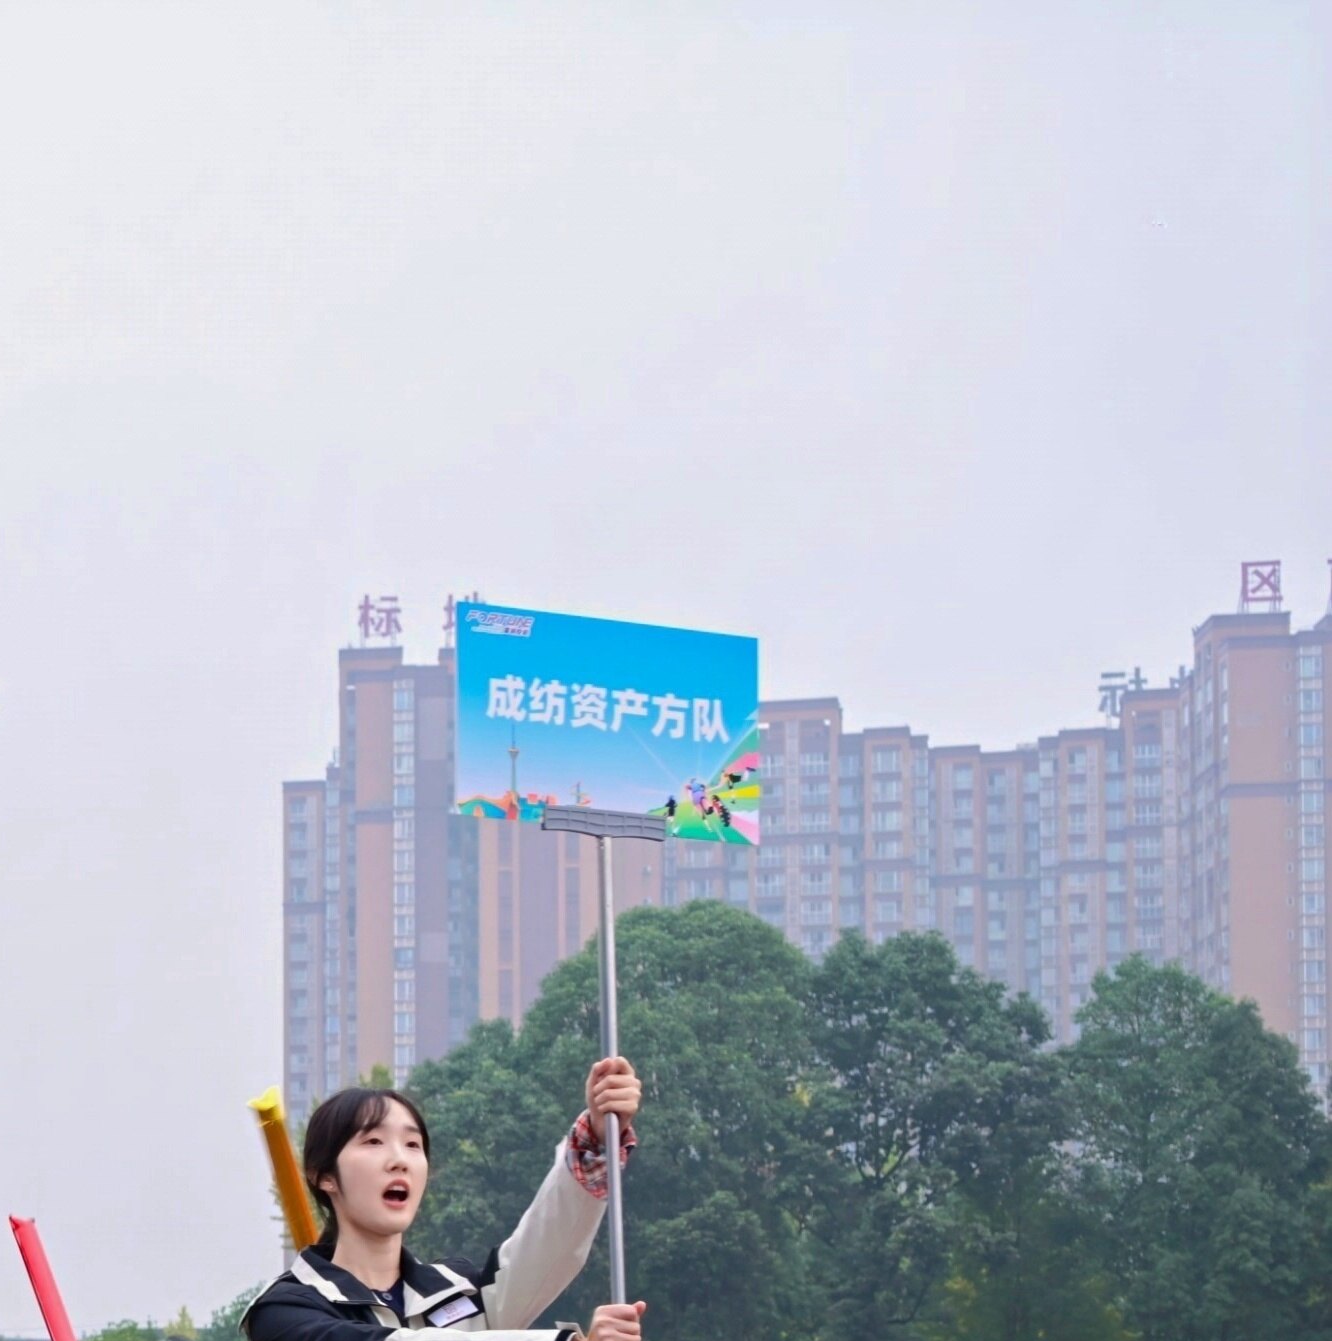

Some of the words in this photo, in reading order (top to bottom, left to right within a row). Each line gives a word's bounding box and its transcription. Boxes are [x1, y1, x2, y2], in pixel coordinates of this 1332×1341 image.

[486, 674, 730, 744] 成纺资产方队
